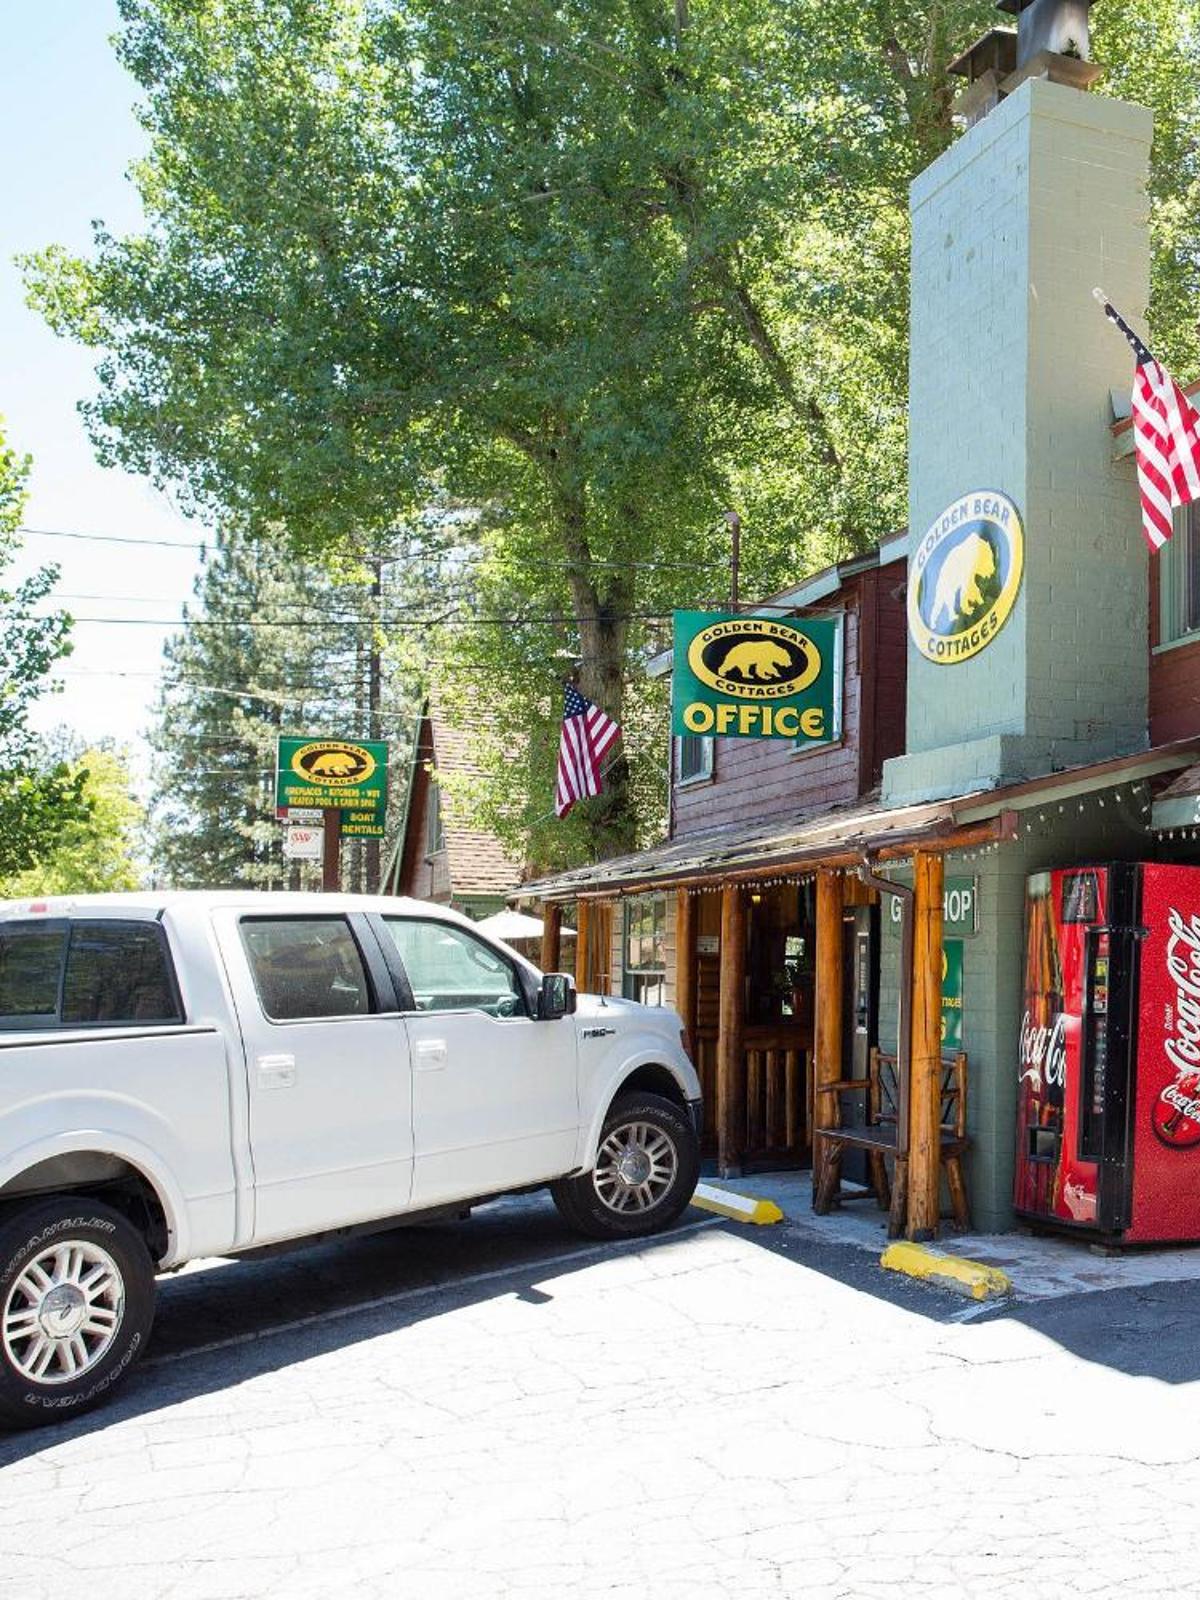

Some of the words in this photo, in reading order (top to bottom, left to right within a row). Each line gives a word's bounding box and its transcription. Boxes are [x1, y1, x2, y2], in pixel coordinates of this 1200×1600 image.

[917, 503, 969, 568] GOLDEN
[973, 498, 1010, 526] BEAR
[702, 623, 763, 643] GOLDEN
[768, 626, 809, 649] BEAR
[927, 611, 999, 657] COTTAGES
[715, 679, 795, 697] COTTAGES
[682, 702, 825, 738] OFFICE
[300, 743, 339, 754] GOLDEN
[343, 744, 368, 757] BEAR
[308, 775, 359, 785] COTTAGES
[349, 812, 375, 821] BOAT
[341, 825, 384, 834] RENTALS
